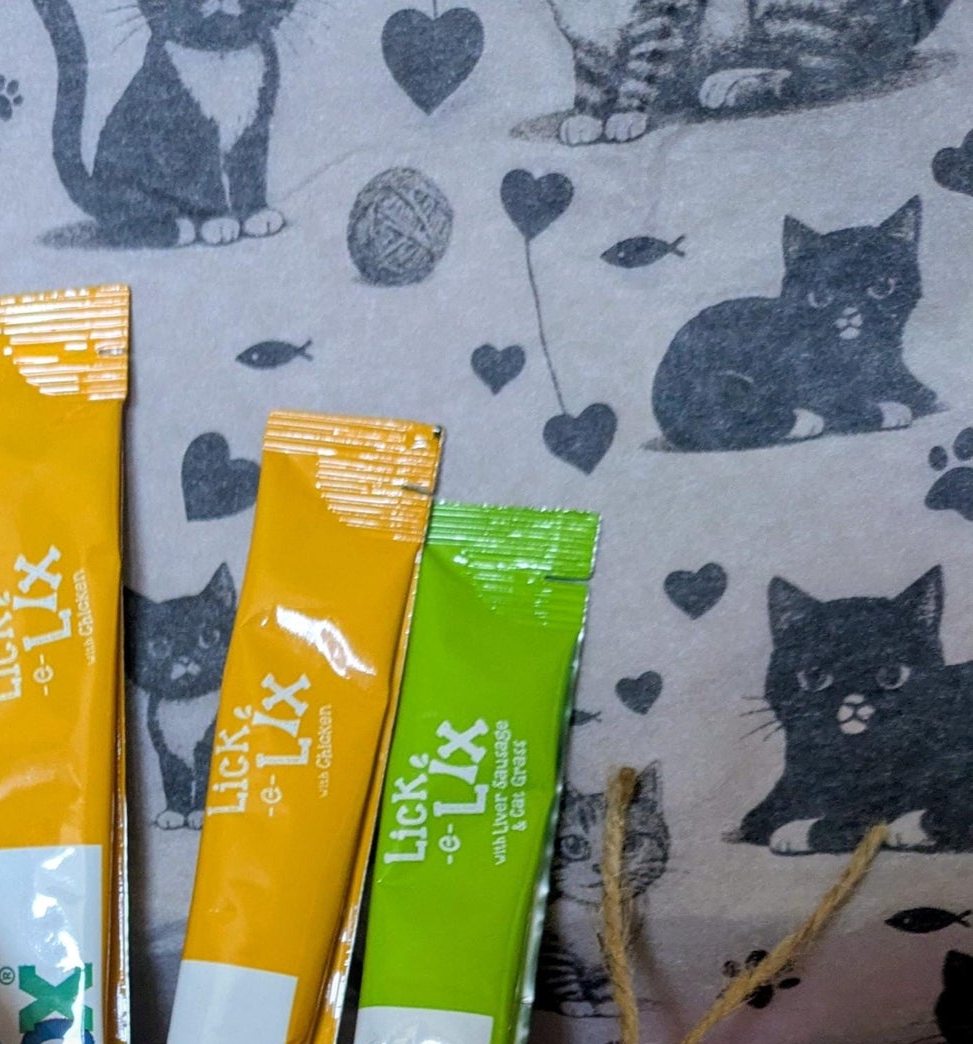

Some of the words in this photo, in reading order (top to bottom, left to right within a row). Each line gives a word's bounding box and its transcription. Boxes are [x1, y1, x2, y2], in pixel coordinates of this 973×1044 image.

[73, 567, 93, 637] Chicken
[316, 704, 332, 769] Chicken
[492, 720, 511, 789] Sausage
[511, 740, 527, 786] Grass
[492, 793, 508, 835] Liver
[510, 791, 525, 817] Cat
[512, 820, 527, 831] &
[492, 837, 506, 865] with
